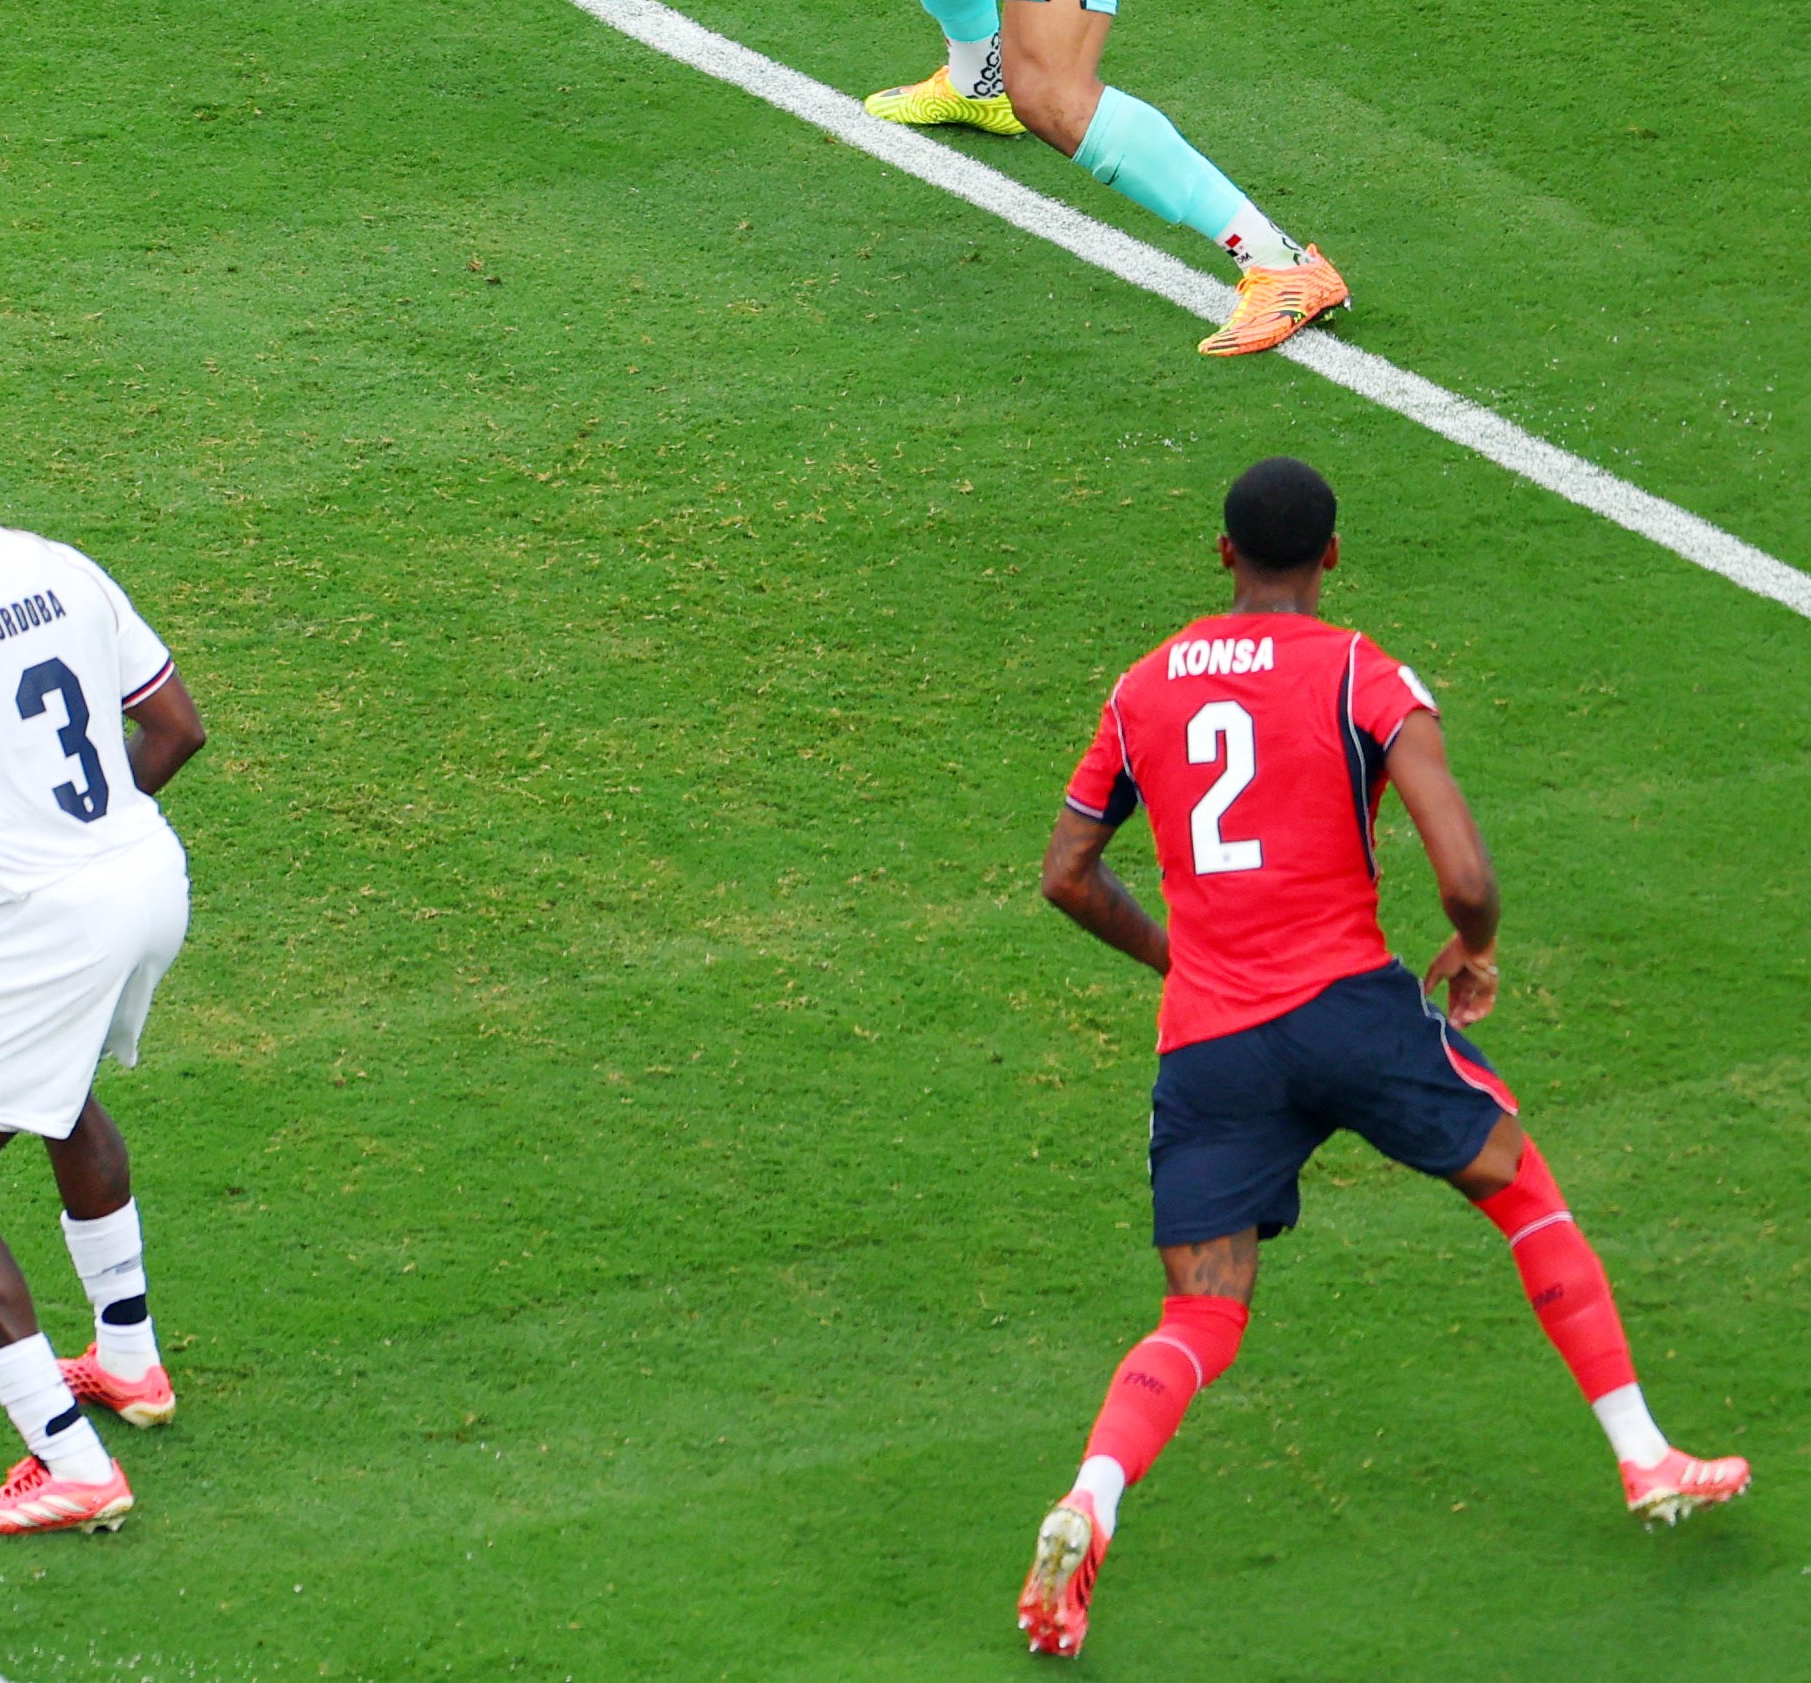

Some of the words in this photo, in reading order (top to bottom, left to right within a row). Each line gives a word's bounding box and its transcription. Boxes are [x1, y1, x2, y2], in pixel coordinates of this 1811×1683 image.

[15, 656, 110, 824] 3
[1166, 636, 1275, 681] KONSA
[1185, 699, 1264, 877] 2
